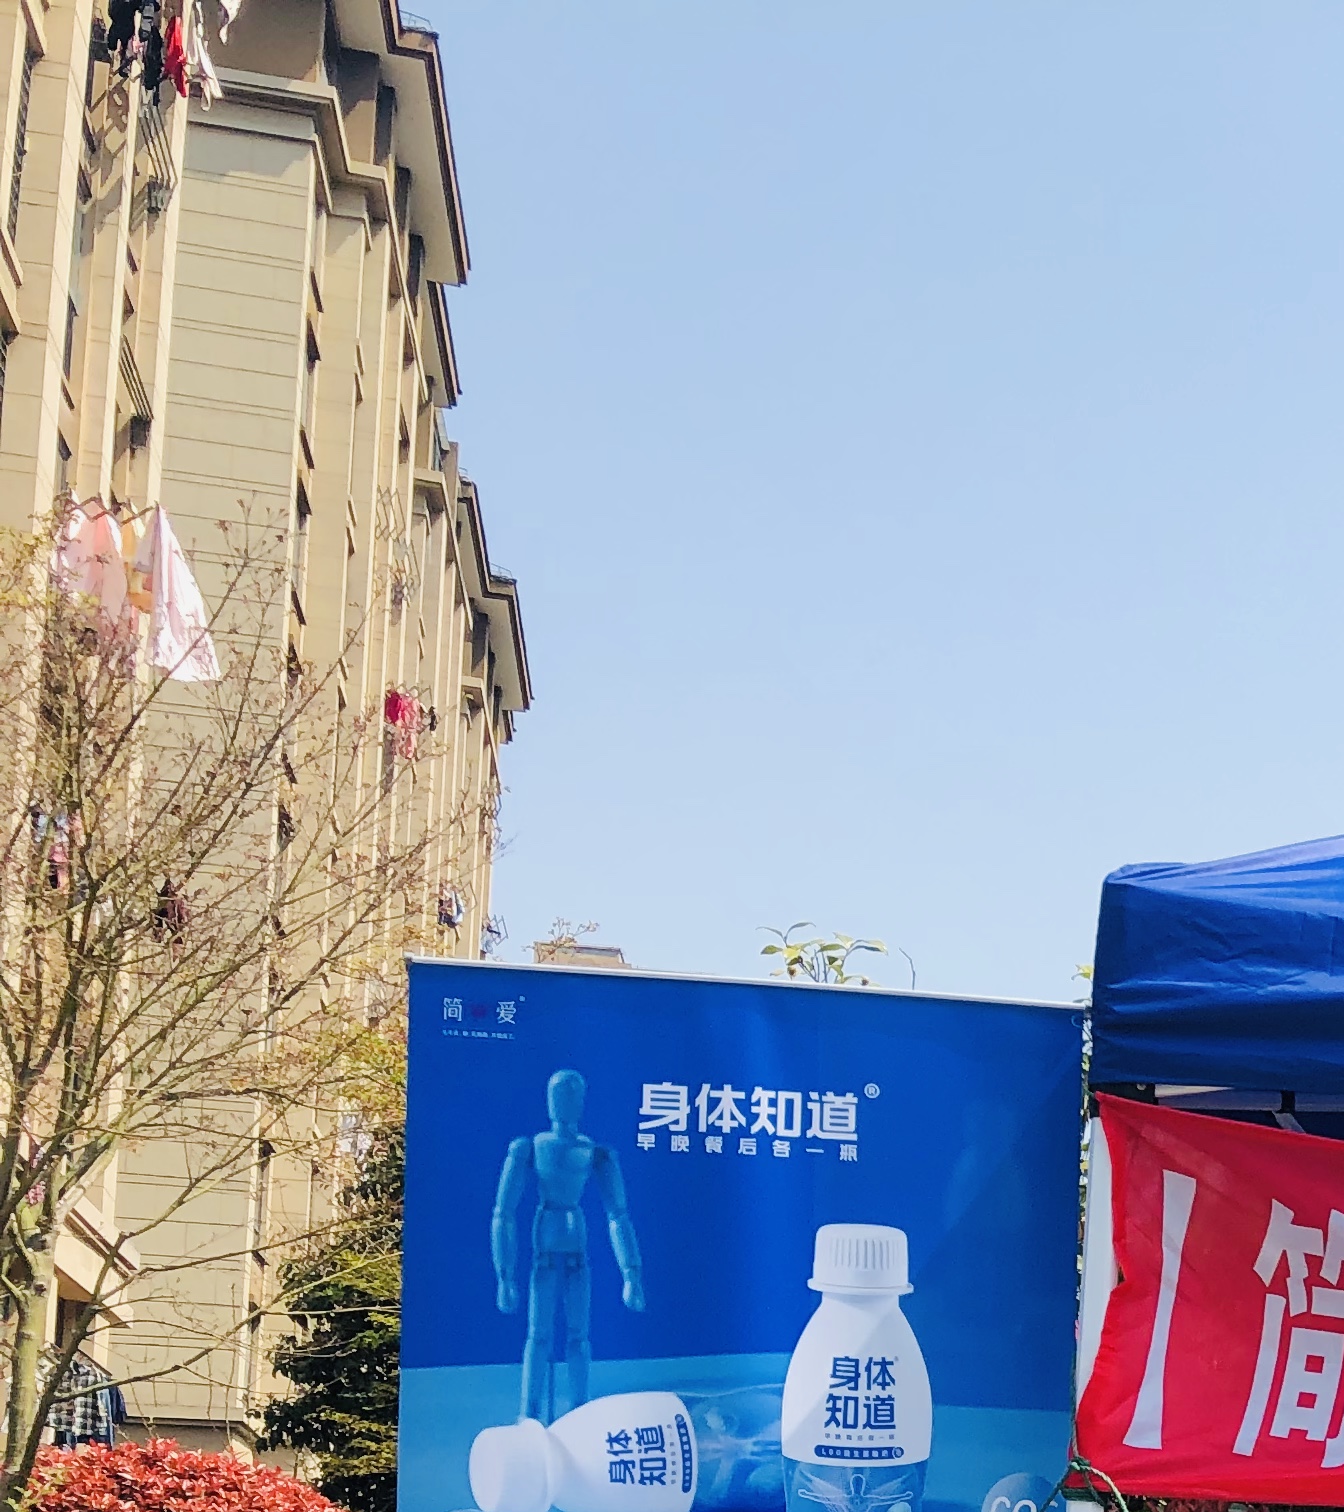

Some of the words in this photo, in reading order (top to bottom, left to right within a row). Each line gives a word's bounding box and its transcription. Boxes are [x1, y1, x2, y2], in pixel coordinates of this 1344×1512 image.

[638, 1082, 858, 1142] 身体知道
[637, 1133, 858, 1162] 早晚餐后各一瓶
[829, 1356, 896, 1391] 身体
[824, 1393, 896, 1430] 知道
